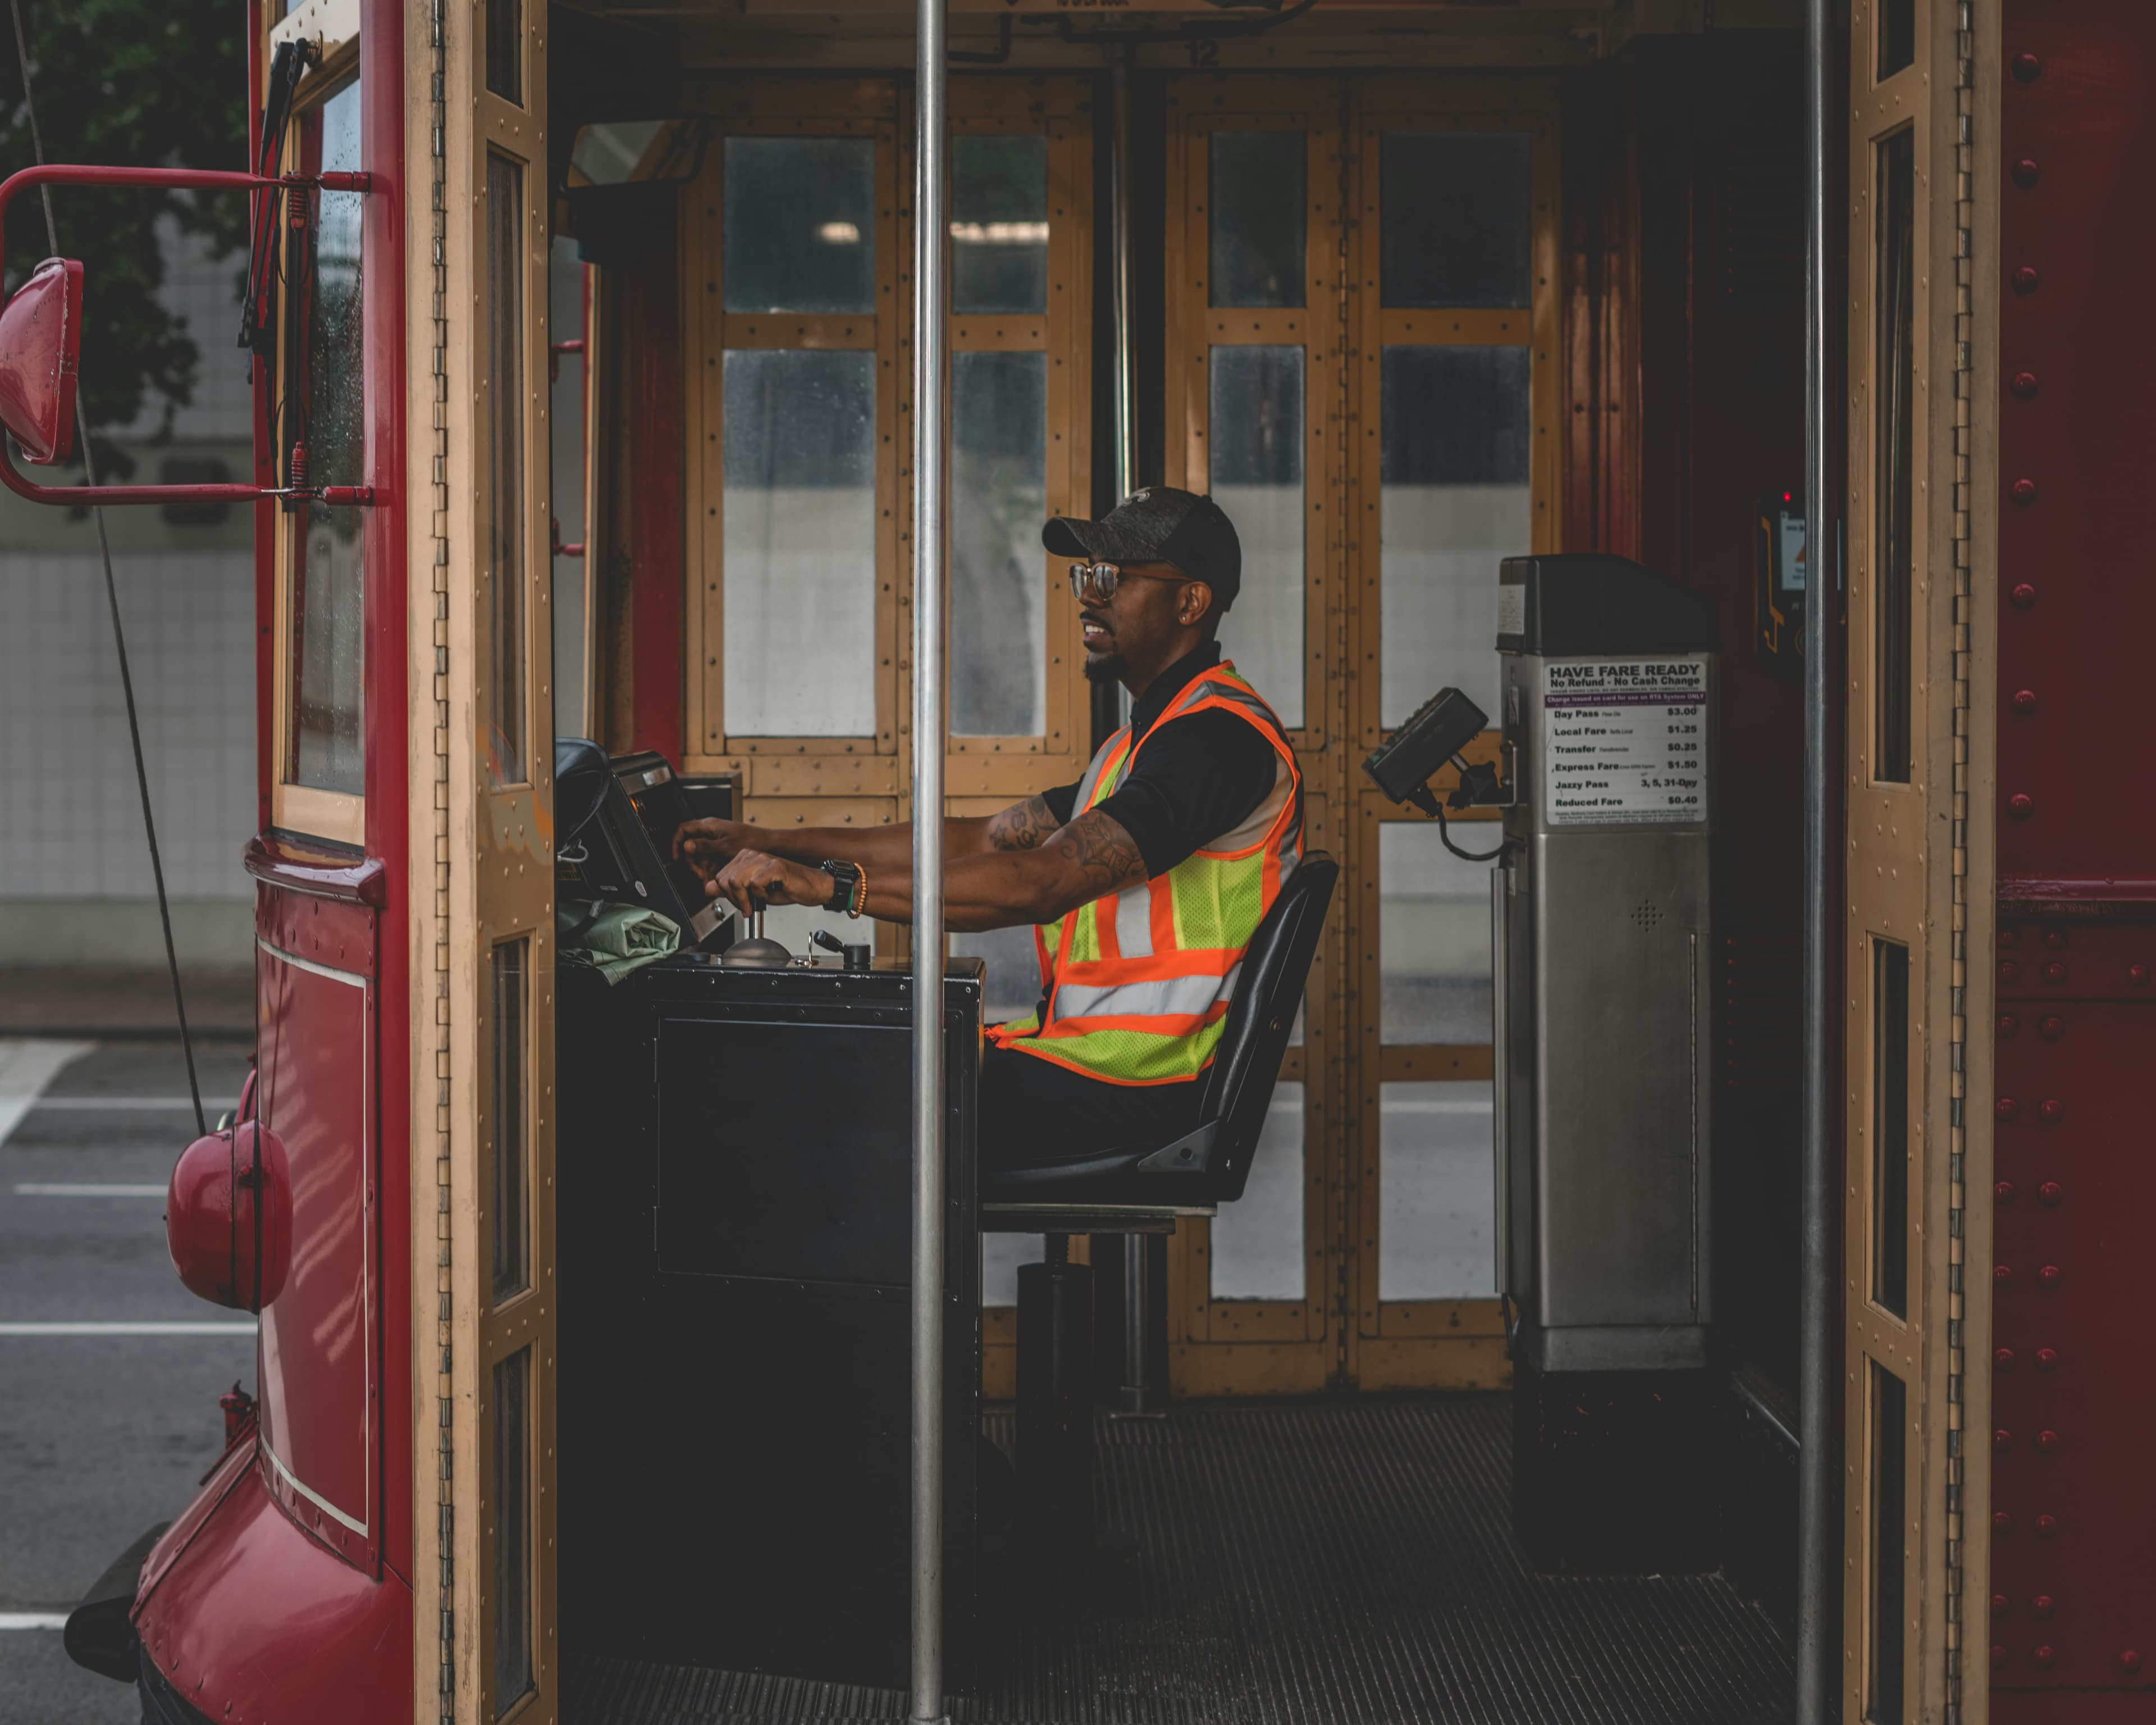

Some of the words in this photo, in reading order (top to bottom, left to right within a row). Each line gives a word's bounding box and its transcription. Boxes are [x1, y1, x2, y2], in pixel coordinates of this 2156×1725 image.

[1184, 39, 1218, 66] 12
[1550, 667, 1594, 678] HAVE
[1598, 665, 1640, 677] FARE
[1645, 664, 1700, 676] READY
[1551, 678, 1565, 687] No
[1568, 678, 1605, 687] Refund
[1614, 677, 1628, 686] No
[1632, 677, 1657, 685] Cash
[1661, 676, 1700, 687] Change
[1554, 710, 1573, 720] Day
[1668, 725, 1697, 733] $1.25
[1555, 745, 1596, 754] Transfer
[1668, 742, 1697, 751] $0.25
[1555, 764, 1595, 773] Express
[1668, 760, 1697, 769] $1.50
[1555, 781, 1583, 791] Jazzy
[1641, 779, 1650, 788] 3,
[1652, 779, 1661, 788] 5,
[1664, 778, 1697, 788] 31-Day
[1555, 798, 1598, 807] Reduced
[1601, 797, 1623, 806] Fare
[1668, 796, 1698, 804] $0.40
